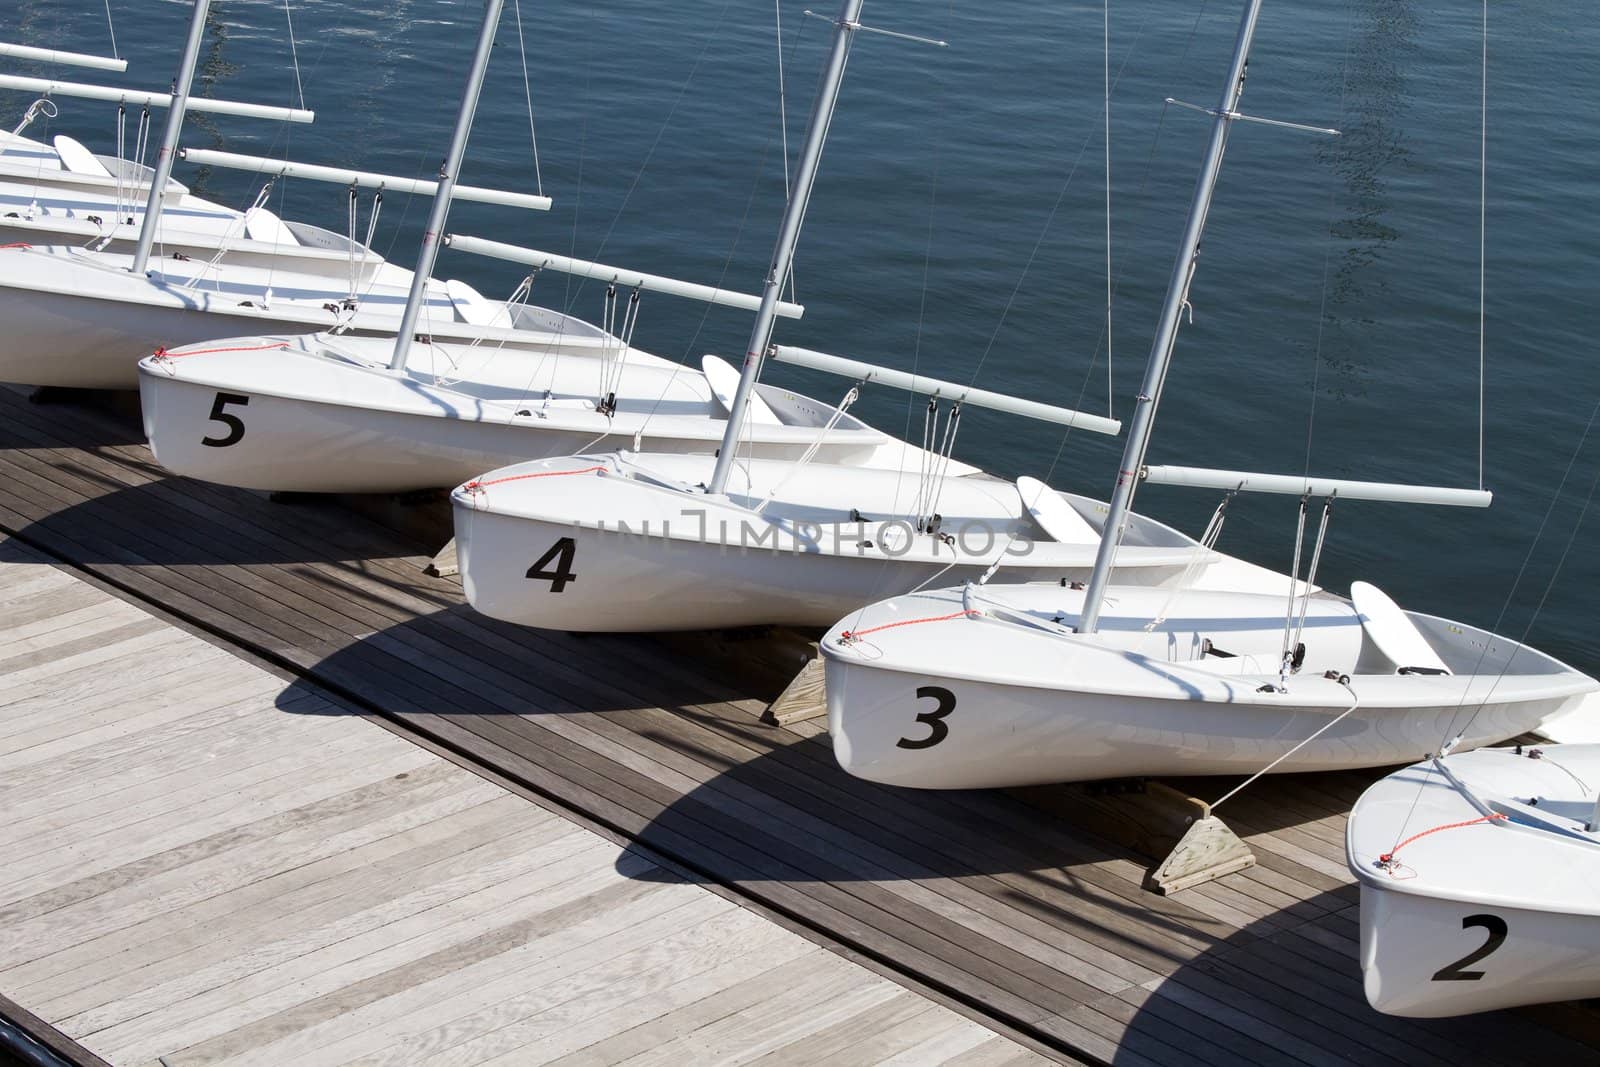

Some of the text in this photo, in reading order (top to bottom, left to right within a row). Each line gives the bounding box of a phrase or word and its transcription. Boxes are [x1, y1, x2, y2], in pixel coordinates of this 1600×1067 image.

[201, 391, 249, 448] 5
[525, 536, 577, 593] 4
[896, 685, 957, 750] 3
[1431, 913, 1509, 982] 2
